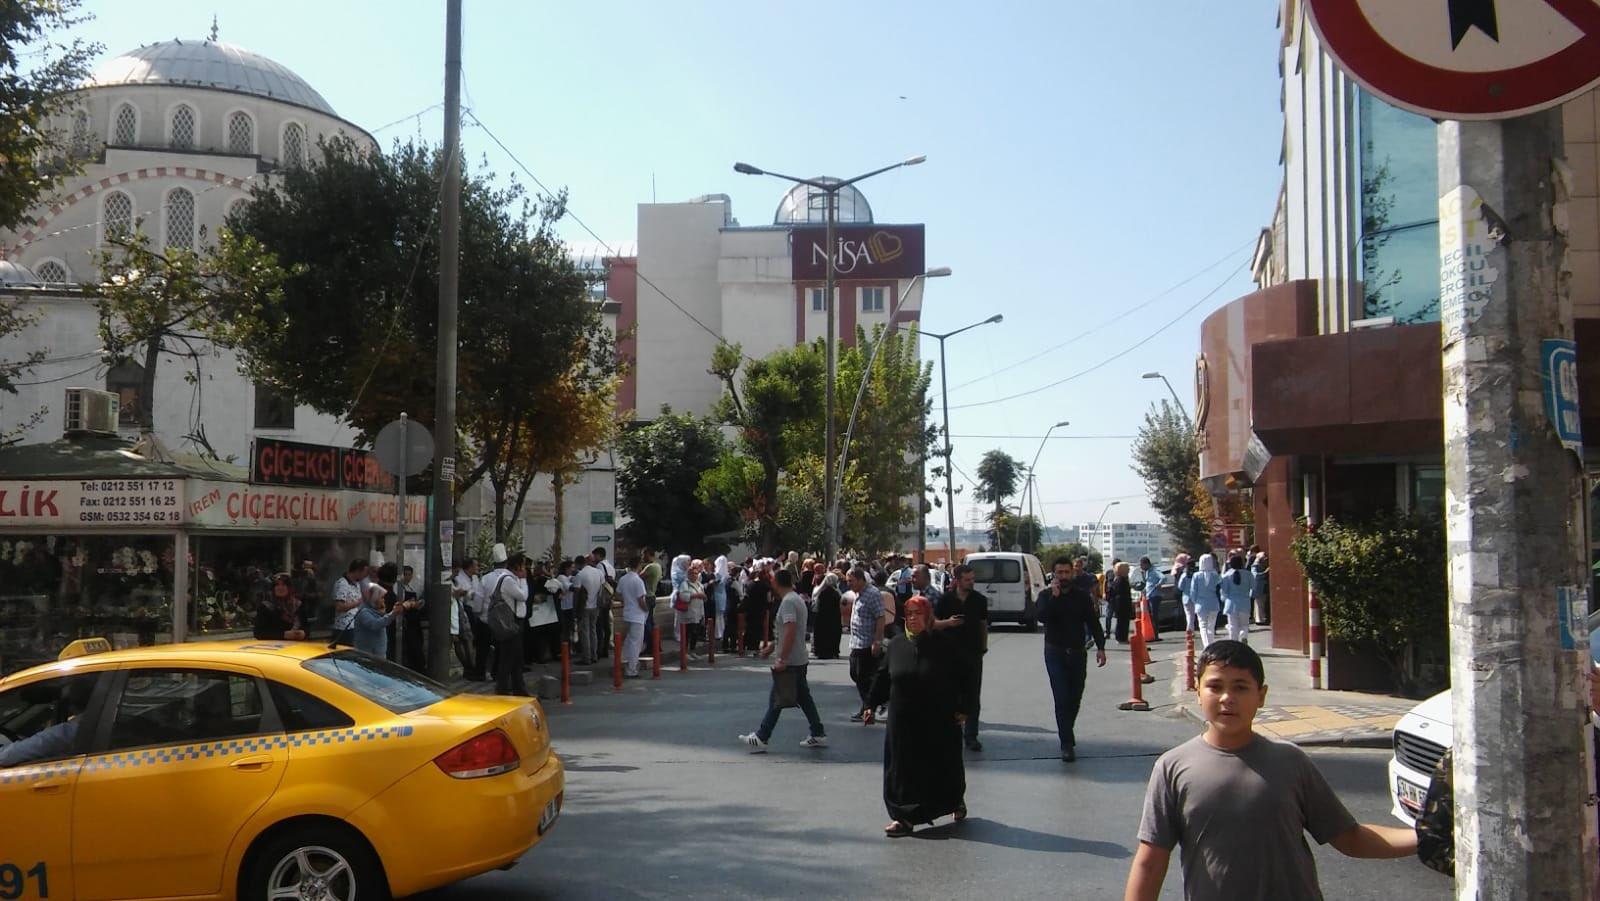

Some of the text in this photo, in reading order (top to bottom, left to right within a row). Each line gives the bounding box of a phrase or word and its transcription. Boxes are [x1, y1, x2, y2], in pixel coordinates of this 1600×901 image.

[812, 237, 874, 273] NİSA
[261, 442, 336, 485] ÇİÇEKÇİ
[80, 496, 176, 506] Fax: 0212 551 16 25
[81, 481, 174, 491] Tel: 0212 551 17 12
[80, 511, 180, 521] GSM: 0532 354 62 18
[227, 489, 338, 526] ÇİÇEKÇİLİK
[0, 862, 48, 900] 91
